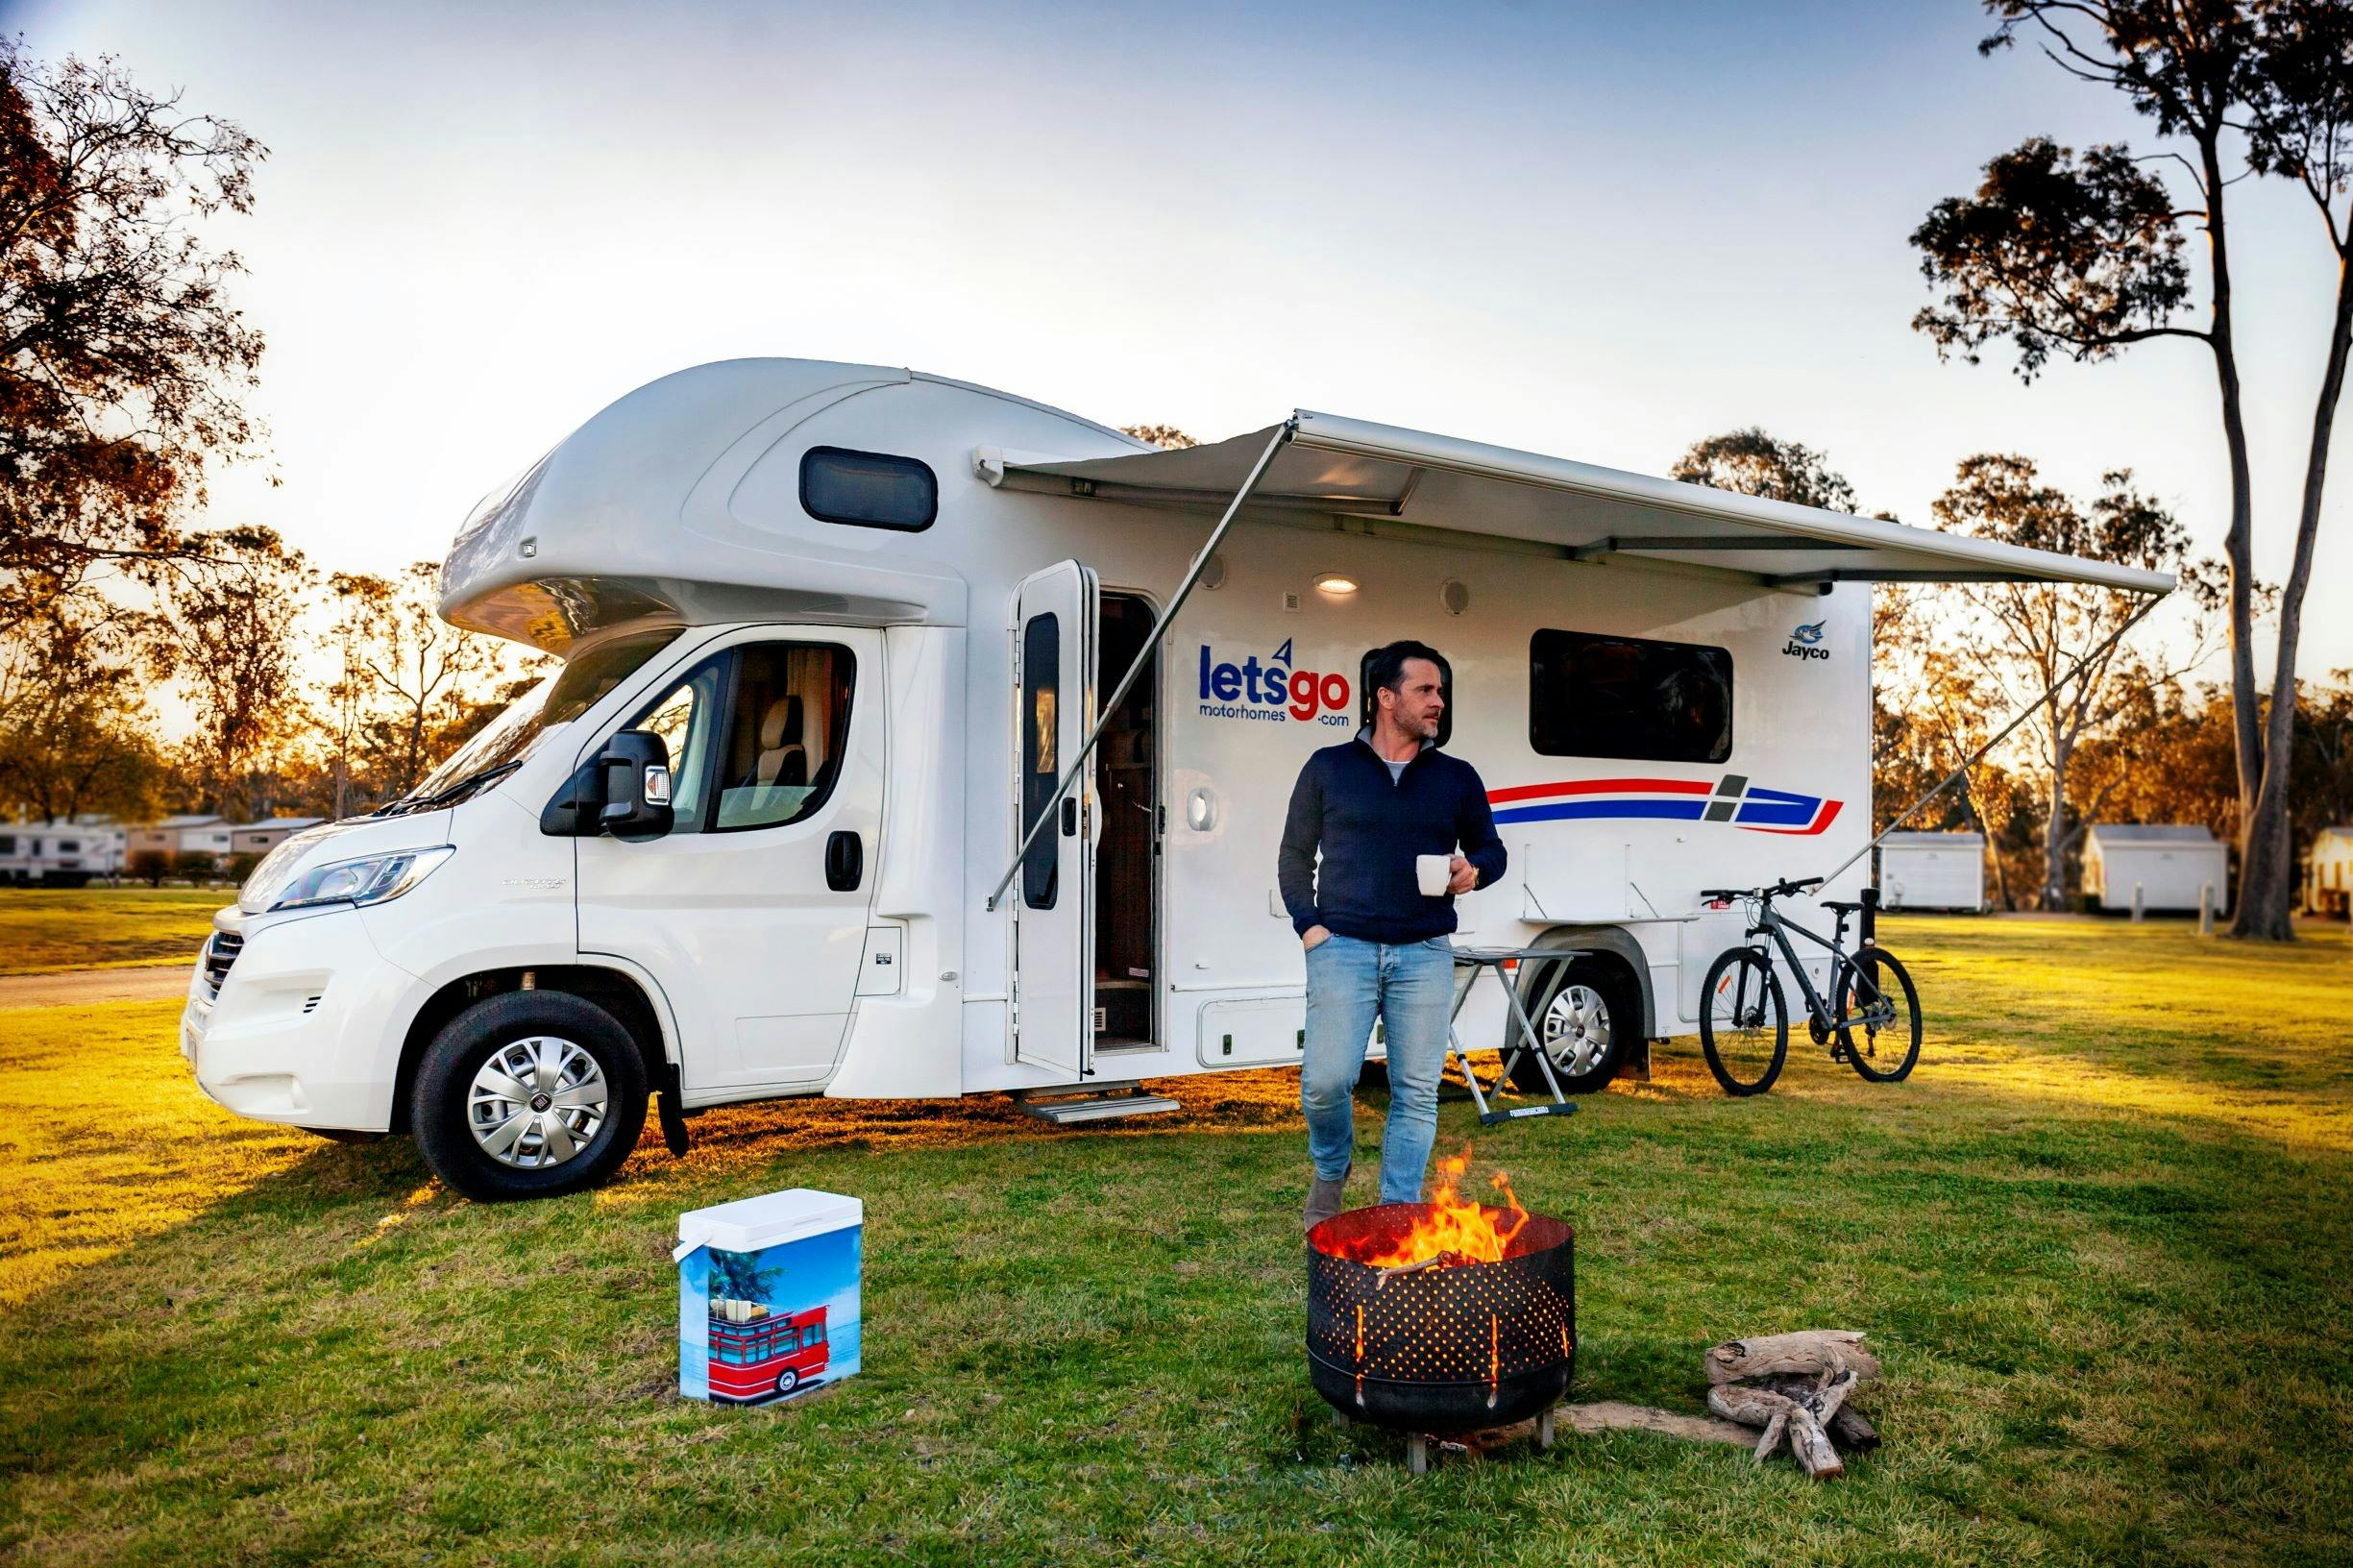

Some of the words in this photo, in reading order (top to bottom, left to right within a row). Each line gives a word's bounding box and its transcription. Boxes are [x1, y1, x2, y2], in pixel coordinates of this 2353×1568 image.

[1782, 640, 1829, 661] Jayco
[1200, 704, 1286, 722] motorhomes
[1317, 714, 1349, 726] .com
